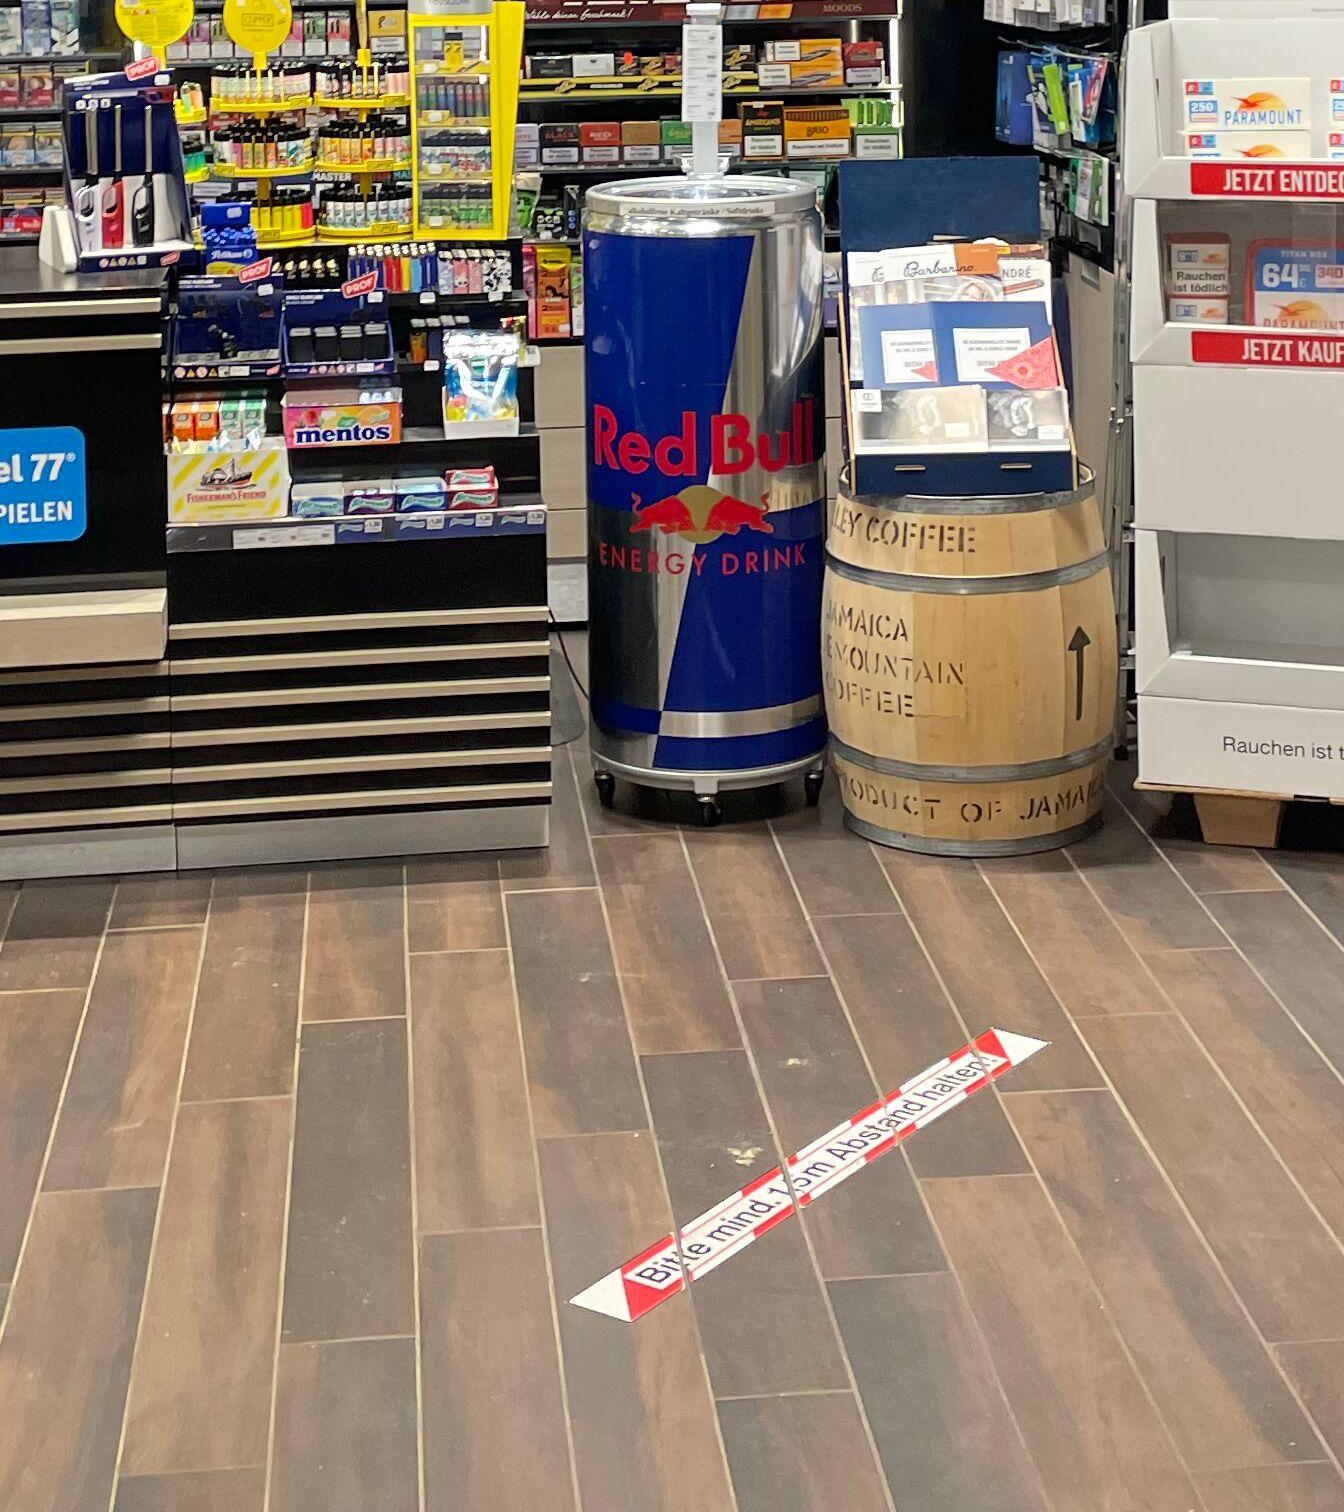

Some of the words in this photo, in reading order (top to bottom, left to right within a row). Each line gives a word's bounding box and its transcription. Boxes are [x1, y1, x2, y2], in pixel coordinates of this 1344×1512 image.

[822, 3, 863, 13] MOODS
[1191, 101, 1216, 113] 250
[1223, 108, 1303, 127] PARAMOUNT
[1222, 168, 1276, 193] JETZT
[1176, 271, 1226, 281] Rauchen
[1241, 338, 1295, 362] JETZT
[295, 424, 391, 444] mentos
[593, 403, 698, 477] Red
[710, 398, 814, 476] Bull
[238, 489, 267, 501] FRIEND
[866, 515, 977, 554] COFFEE
[599, 541, 707, 577] ENERGY
[721, 541, 806, 577] DRINK
[826, 598, 909, 643] JAMAICA
[834, 642, 965, 686] MOUNTAIN
[826, 670, 915, 719] COFFEE
[1222, 736, 1306, 758] Rauchen
[1311, 742, 1334, 760] ist
[960, 800, 1003, 824] OF
[635, 1237, 711, 1285] Bitte
[705, 1195, 783, 1243] mind.
[837, 1097, 927, 1162] Abstand
[918, 1055, 1000, 1111] halten!
